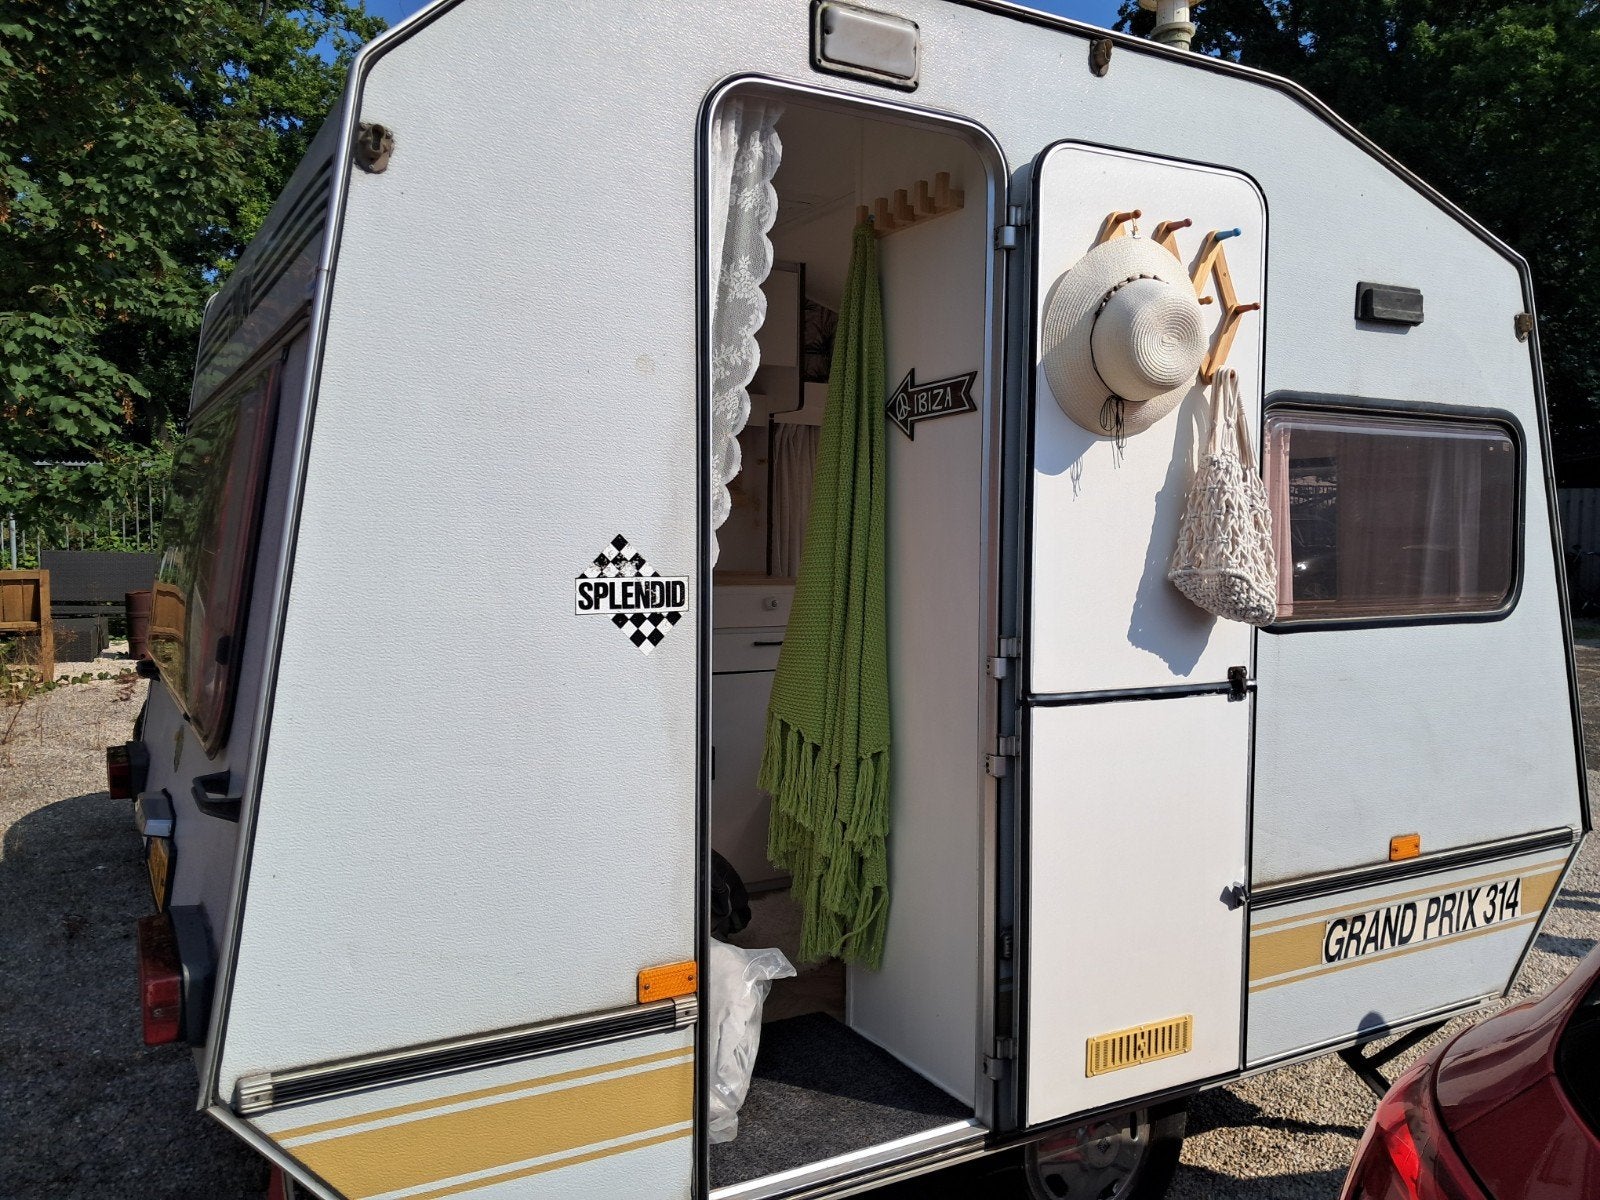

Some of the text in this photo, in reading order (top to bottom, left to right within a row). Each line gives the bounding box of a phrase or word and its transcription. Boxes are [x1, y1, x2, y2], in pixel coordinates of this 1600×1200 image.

[914, 386, 952, 414] IBIZA
[578, 580, 686, 611] SPLENDID
[1324, 877, 1521, 964] GRAND PRIX 314
